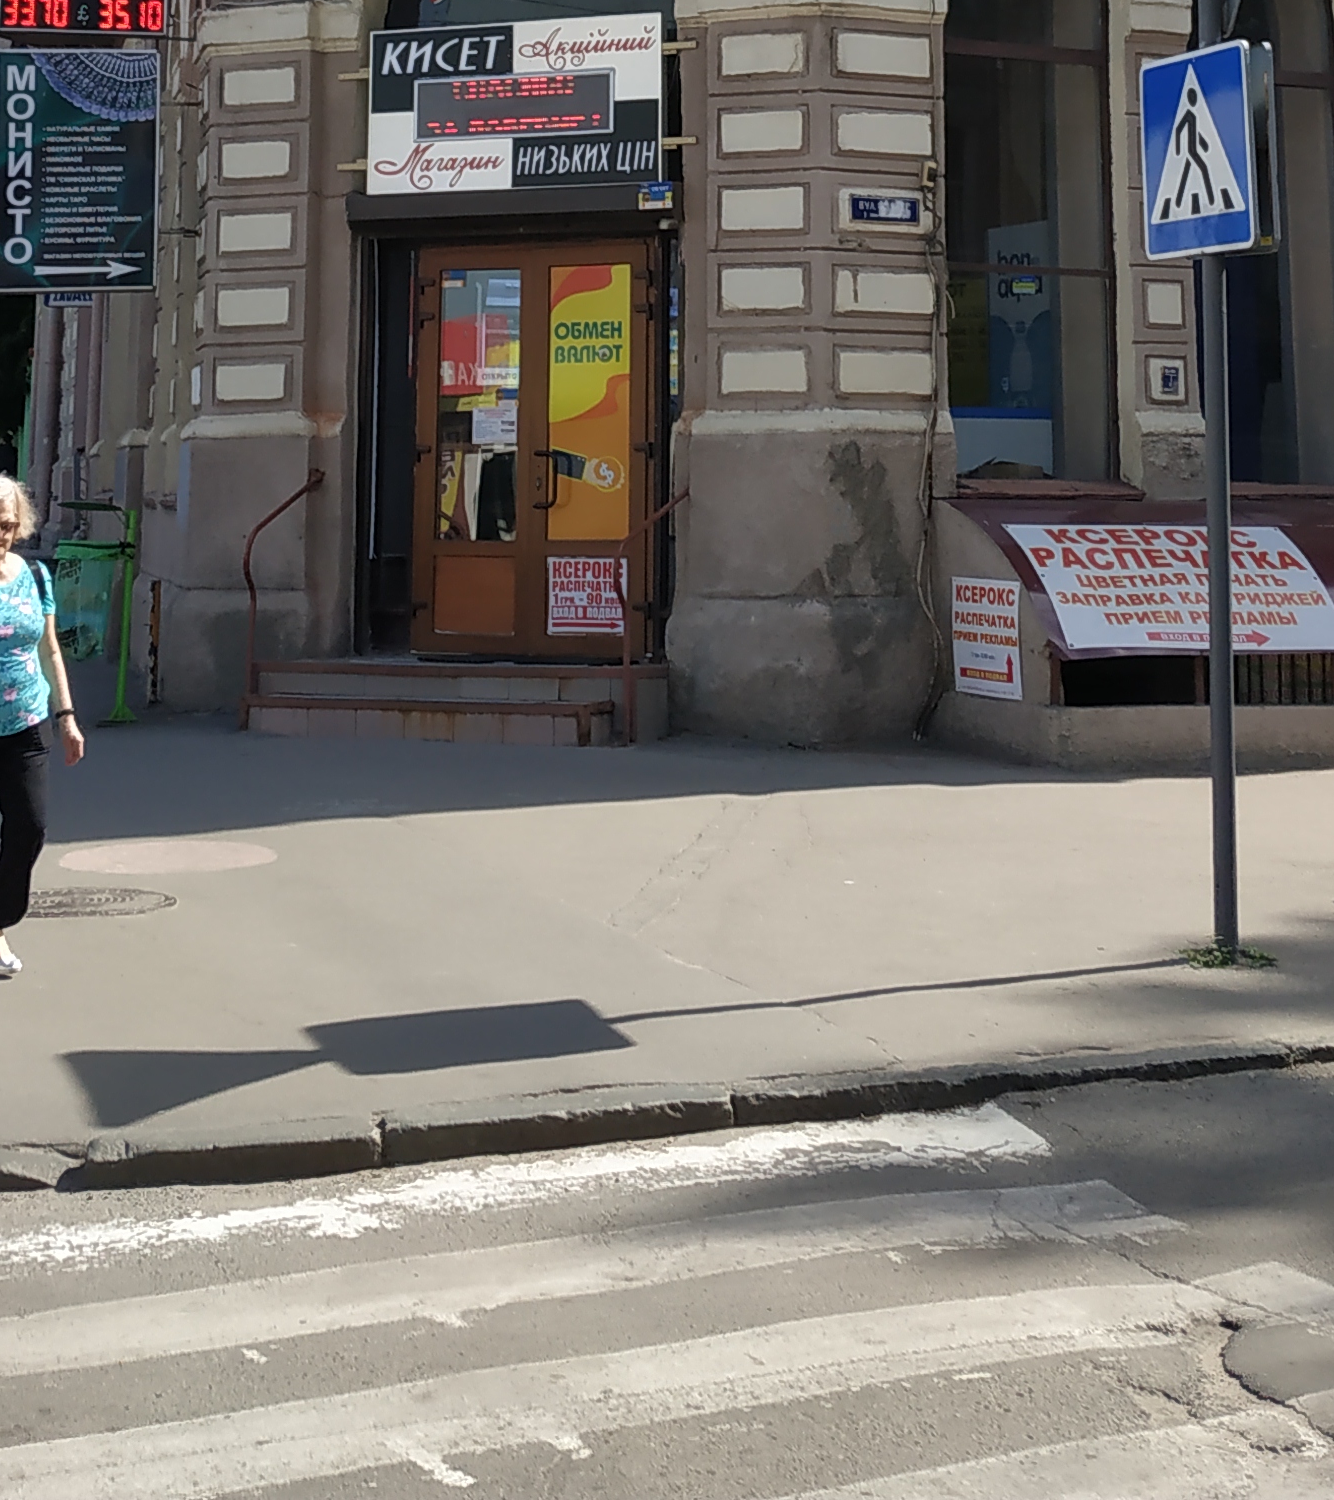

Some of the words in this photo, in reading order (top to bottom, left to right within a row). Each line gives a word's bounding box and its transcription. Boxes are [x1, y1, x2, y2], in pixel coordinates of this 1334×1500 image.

[381, 35, 506, 76] КИСЕТ
[518, 25, 657, 71] Акційний
[3, 64, 37, 265] МОНИСТО
[373, 142, 505, 191] Магазин
[516, 143, 610, 176] НИЗЬКИХ
[616, 140, 657, 175] ЦІН
[554, 321, 623, 339] ОБМЕН
[554, 344, 624, 363] ВАЛЮТ
[1042, 528, 1259, 549] КСЕРОС
[1075, 572, 1191, 591] ЦВЕТНАЯ
[1194, 573, 1289, 589] ПЧАТЬ
[587, 593, 603, 605] 90
[955, 584, 1016, 607] КСЕРОКС
[1055, 591, 1175, 608] ЗАПРАВКА
[1178, 590, 1328, 608] КАРИДЖЕЙ
[552, 606, 576, 619] ВХОД
[954, 610, 1017, 630] РАСПЕЧАТКА
[1103, 611, 1185, 626] ПРИЕМ
[953, 630, 979, 643] ПРИЕМ
[979, 632, 1018, 647] РЕКЛАМЫ
